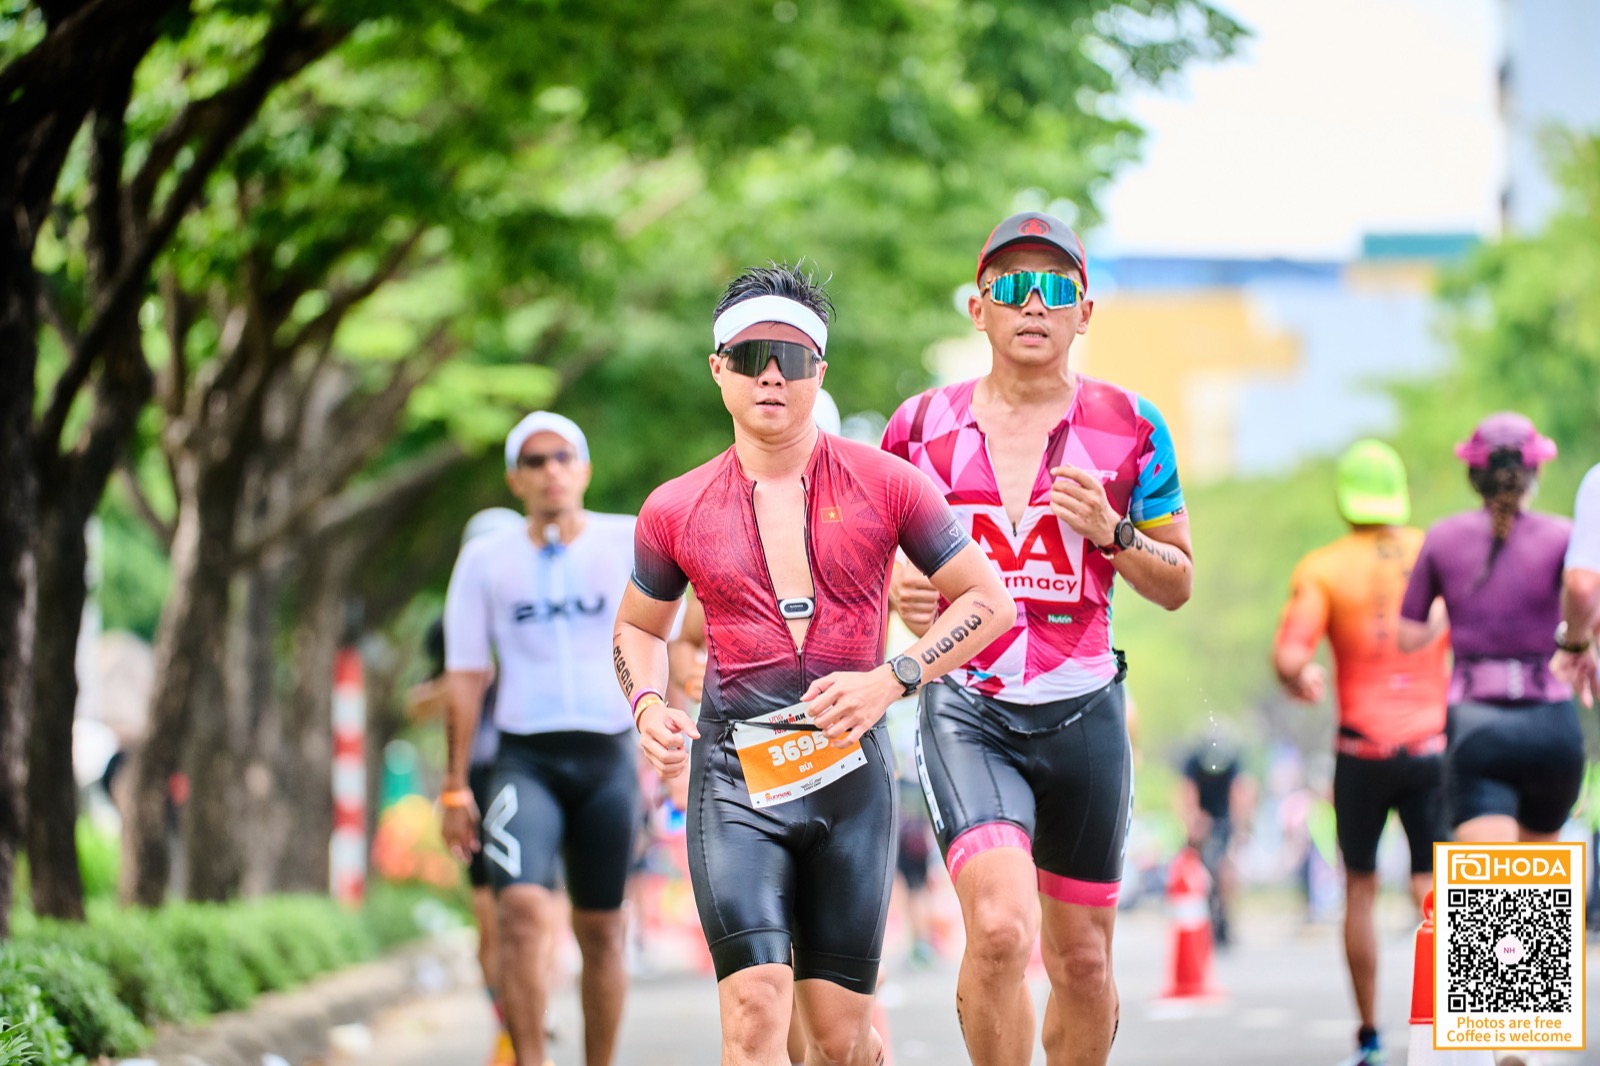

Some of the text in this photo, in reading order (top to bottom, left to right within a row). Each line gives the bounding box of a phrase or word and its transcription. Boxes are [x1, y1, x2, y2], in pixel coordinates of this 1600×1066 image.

[1000, 575, 1078, 594] rmacy
[920, 613, 982, 665] 3695
[767, 732, 829, 767] 3695
